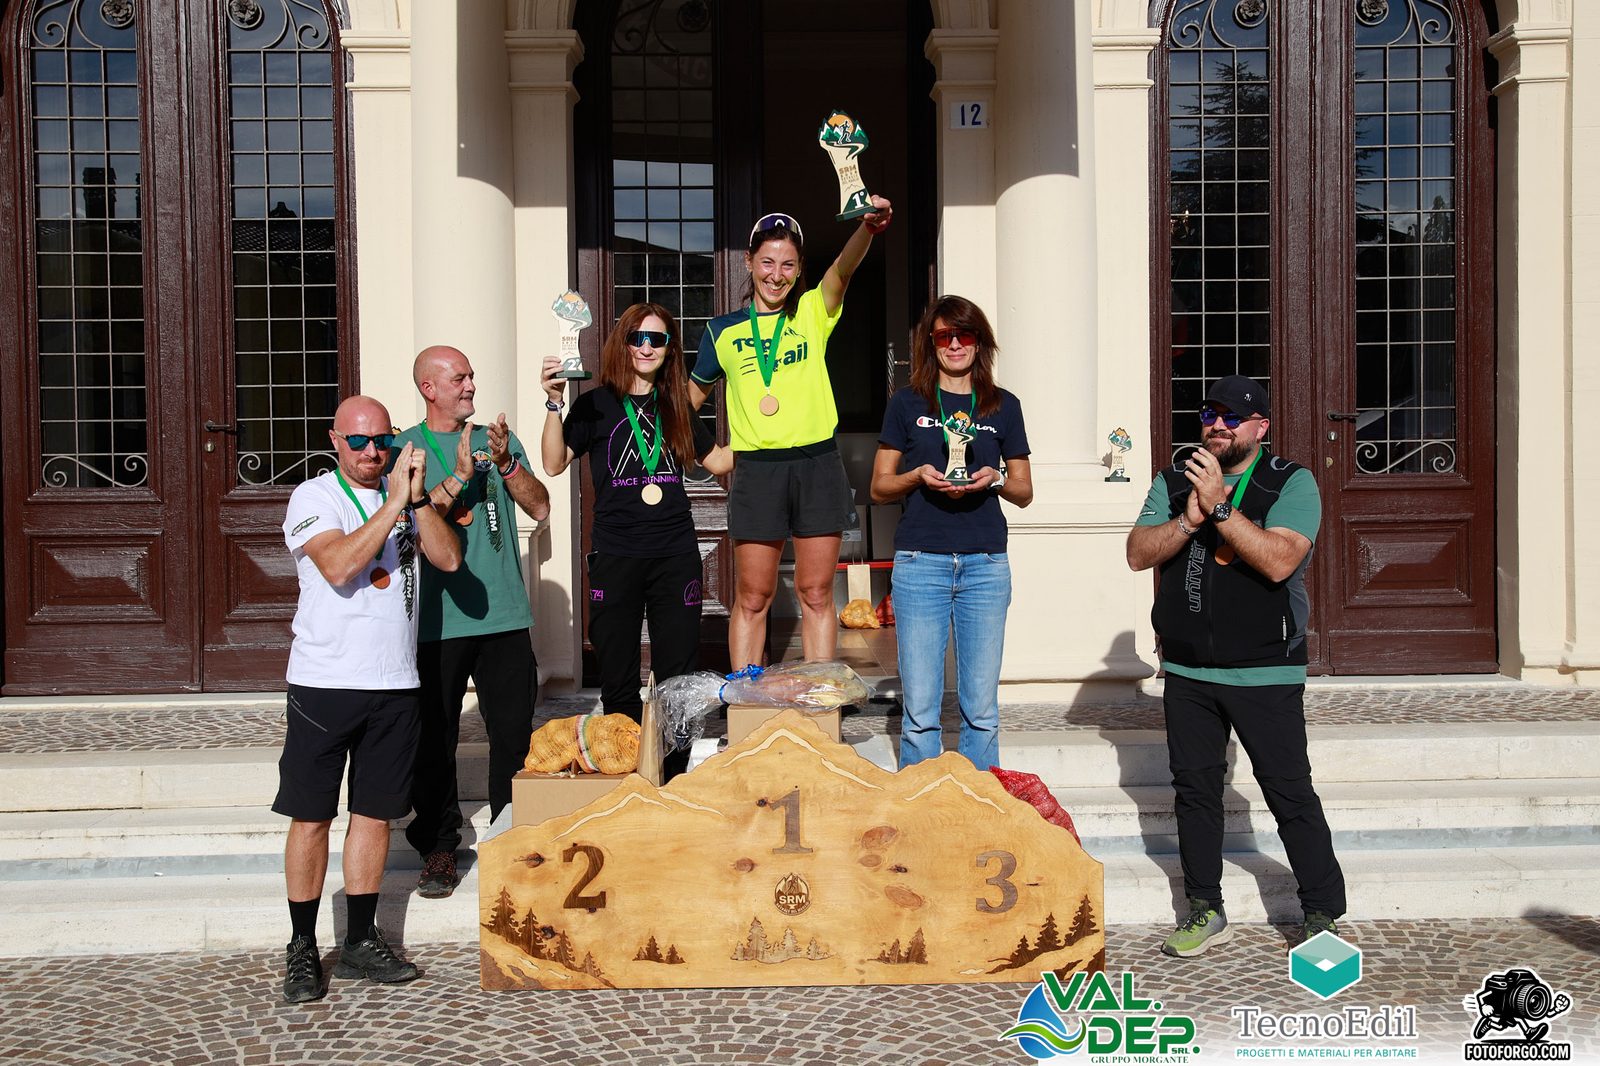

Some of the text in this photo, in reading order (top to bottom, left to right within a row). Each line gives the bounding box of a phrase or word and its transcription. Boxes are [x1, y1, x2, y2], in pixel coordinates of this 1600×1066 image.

[960, 103, 982, 126] 12
[612, 475, 680, 488] SPACE RUNNING
[487, 502, 498, 532] SRM
[404, 567, 412, 598] SRM
[772, 786, 814, 855] 1
[562, 844, 608, 909] 2
[975, 850, 1018, 914] 3
[779, 895, 806, 904] SRM
